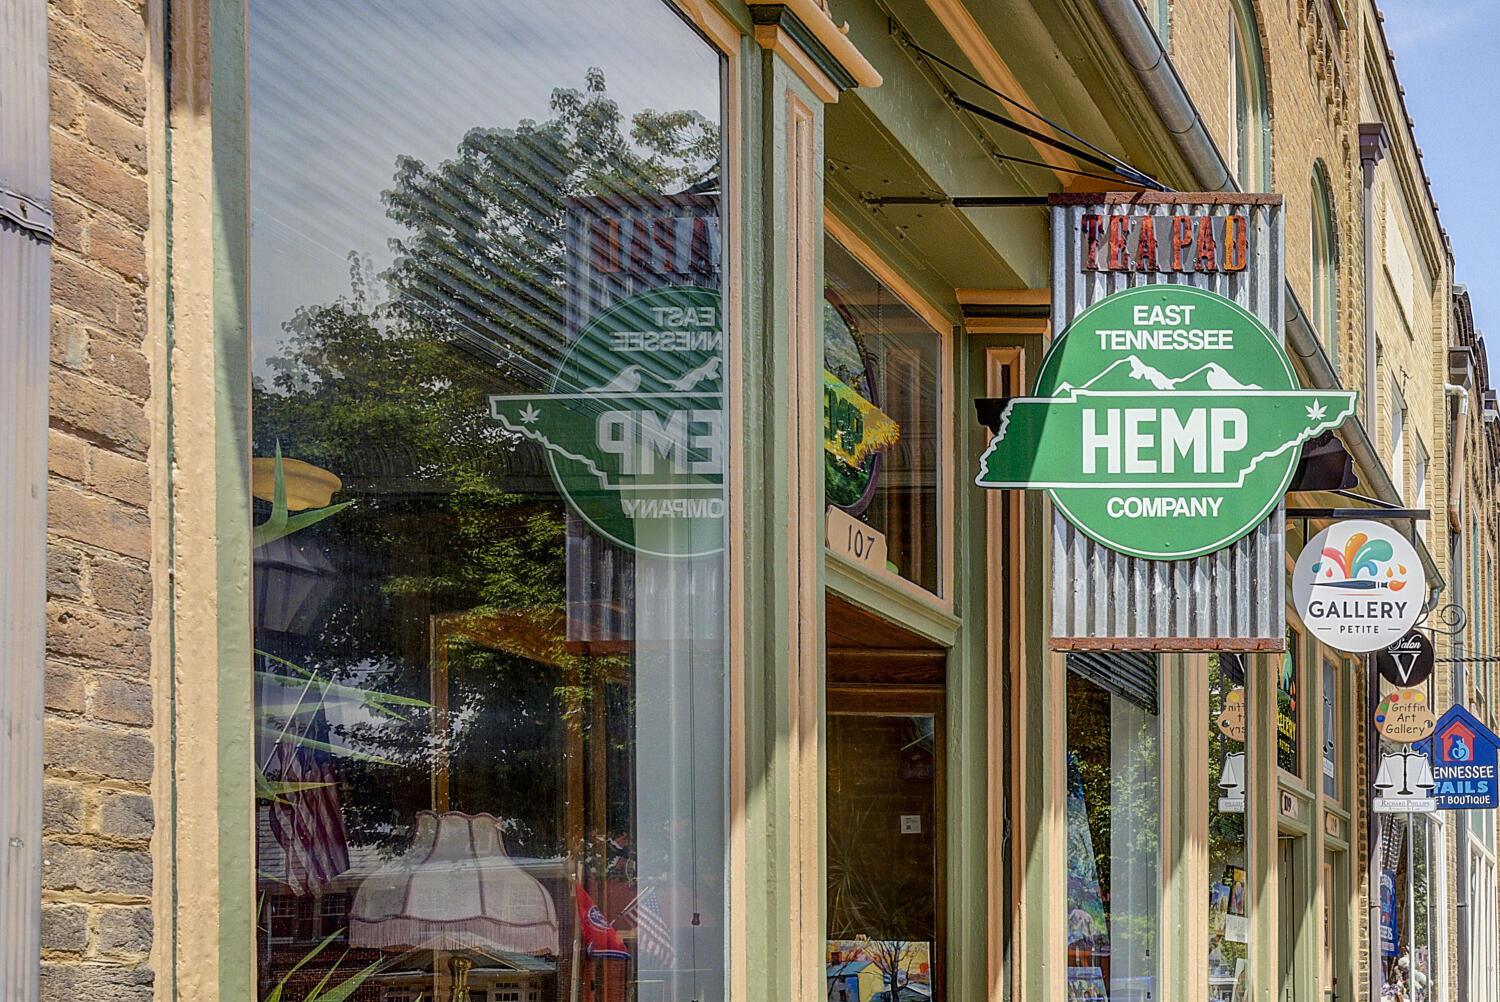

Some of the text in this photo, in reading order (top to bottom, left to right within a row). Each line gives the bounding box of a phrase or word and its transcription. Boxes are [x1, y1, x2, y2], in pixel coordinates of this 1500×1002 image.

[1082, 214, 1248, 271] TEA PAD
[1133, 304, 1195, 326] EAST
[1095, 329, 1233, 350] TENNESSEE
[1082, 407, 1248, 474] HEMP
[1106, 496, 1224, 519] COMPANY
[847, 524, 875, 561] 107
[1308, 600, 1408, 619] GALLERY
[1340, 625, 1380, 634] PETITE
[1390, 653, 1421, 685] V
[1391, 702, 1426, 712] Griffin
[1396, 713, 1417, 723] Art
[1385, 723, 1425, 737] Gallery
[1433, 765, 1494, 779] ENNESSEE
[1435, 794, 1491, 805] ET BOUTIQUE
